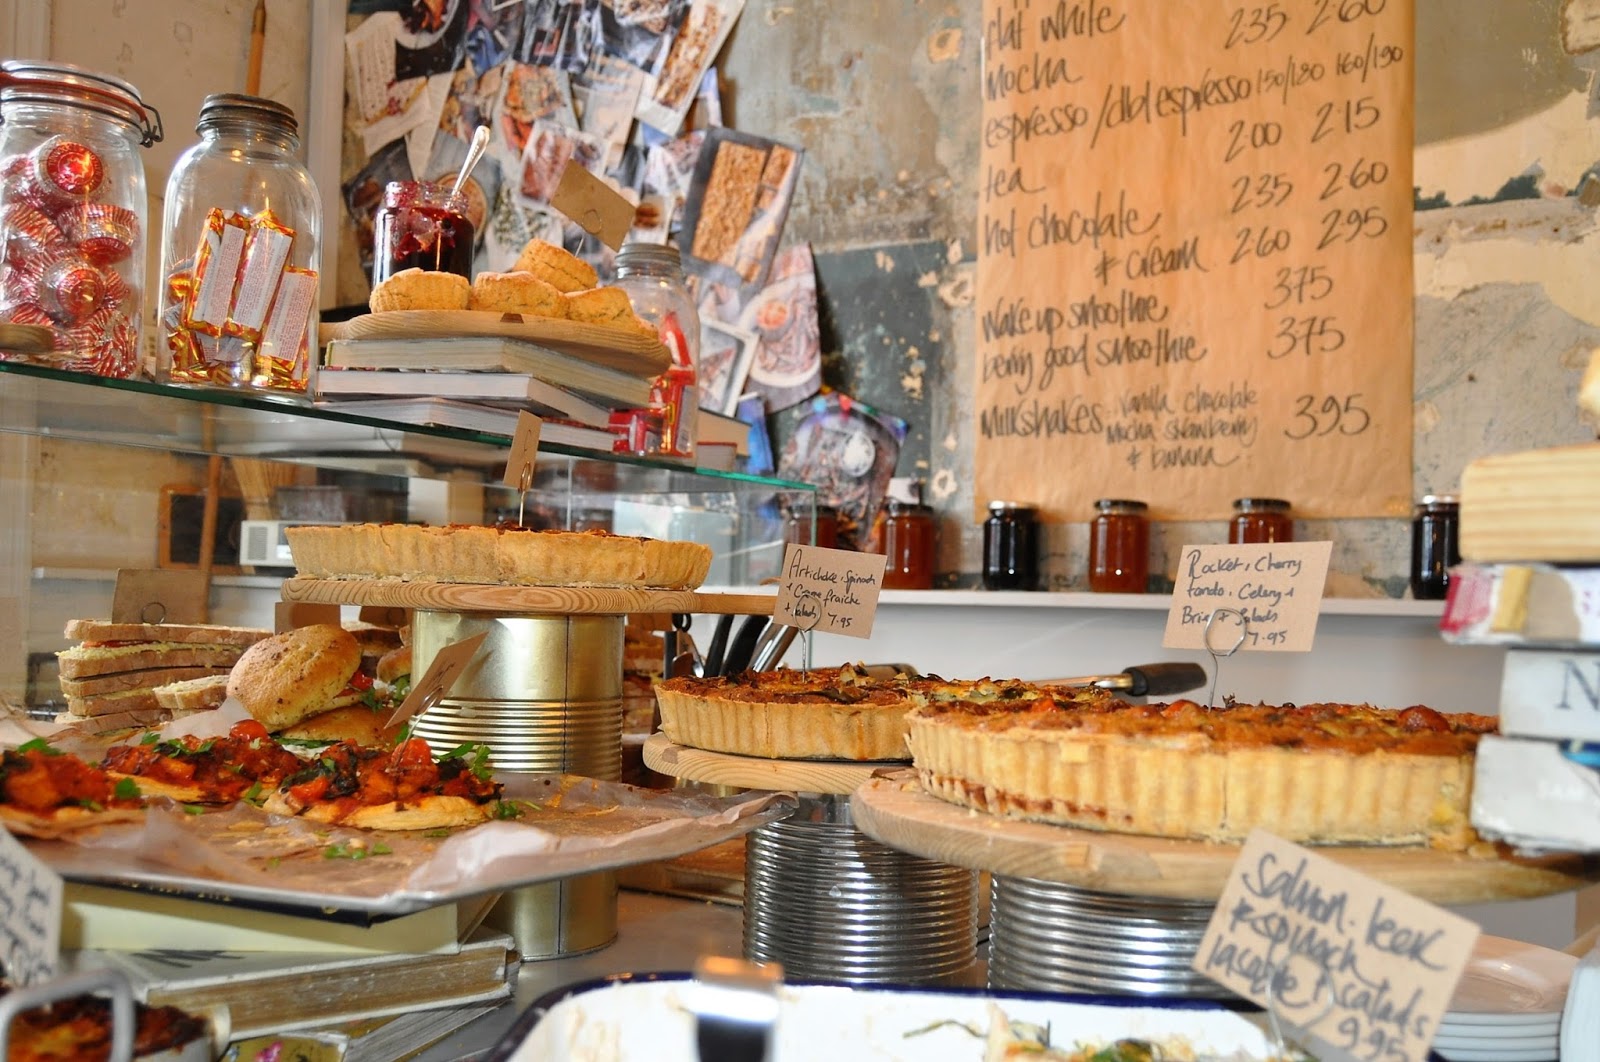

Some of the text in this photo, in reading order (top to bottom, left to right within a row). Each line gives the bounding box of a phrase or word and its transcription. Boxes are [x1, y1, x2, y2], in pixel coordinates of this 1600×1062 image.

[985, 164, 1047, 203] tea
[984, 207, 1019, 259] hot
[827, 612, 853, 629] 7.95
[1246, 629, 1289, 646] 7.95
